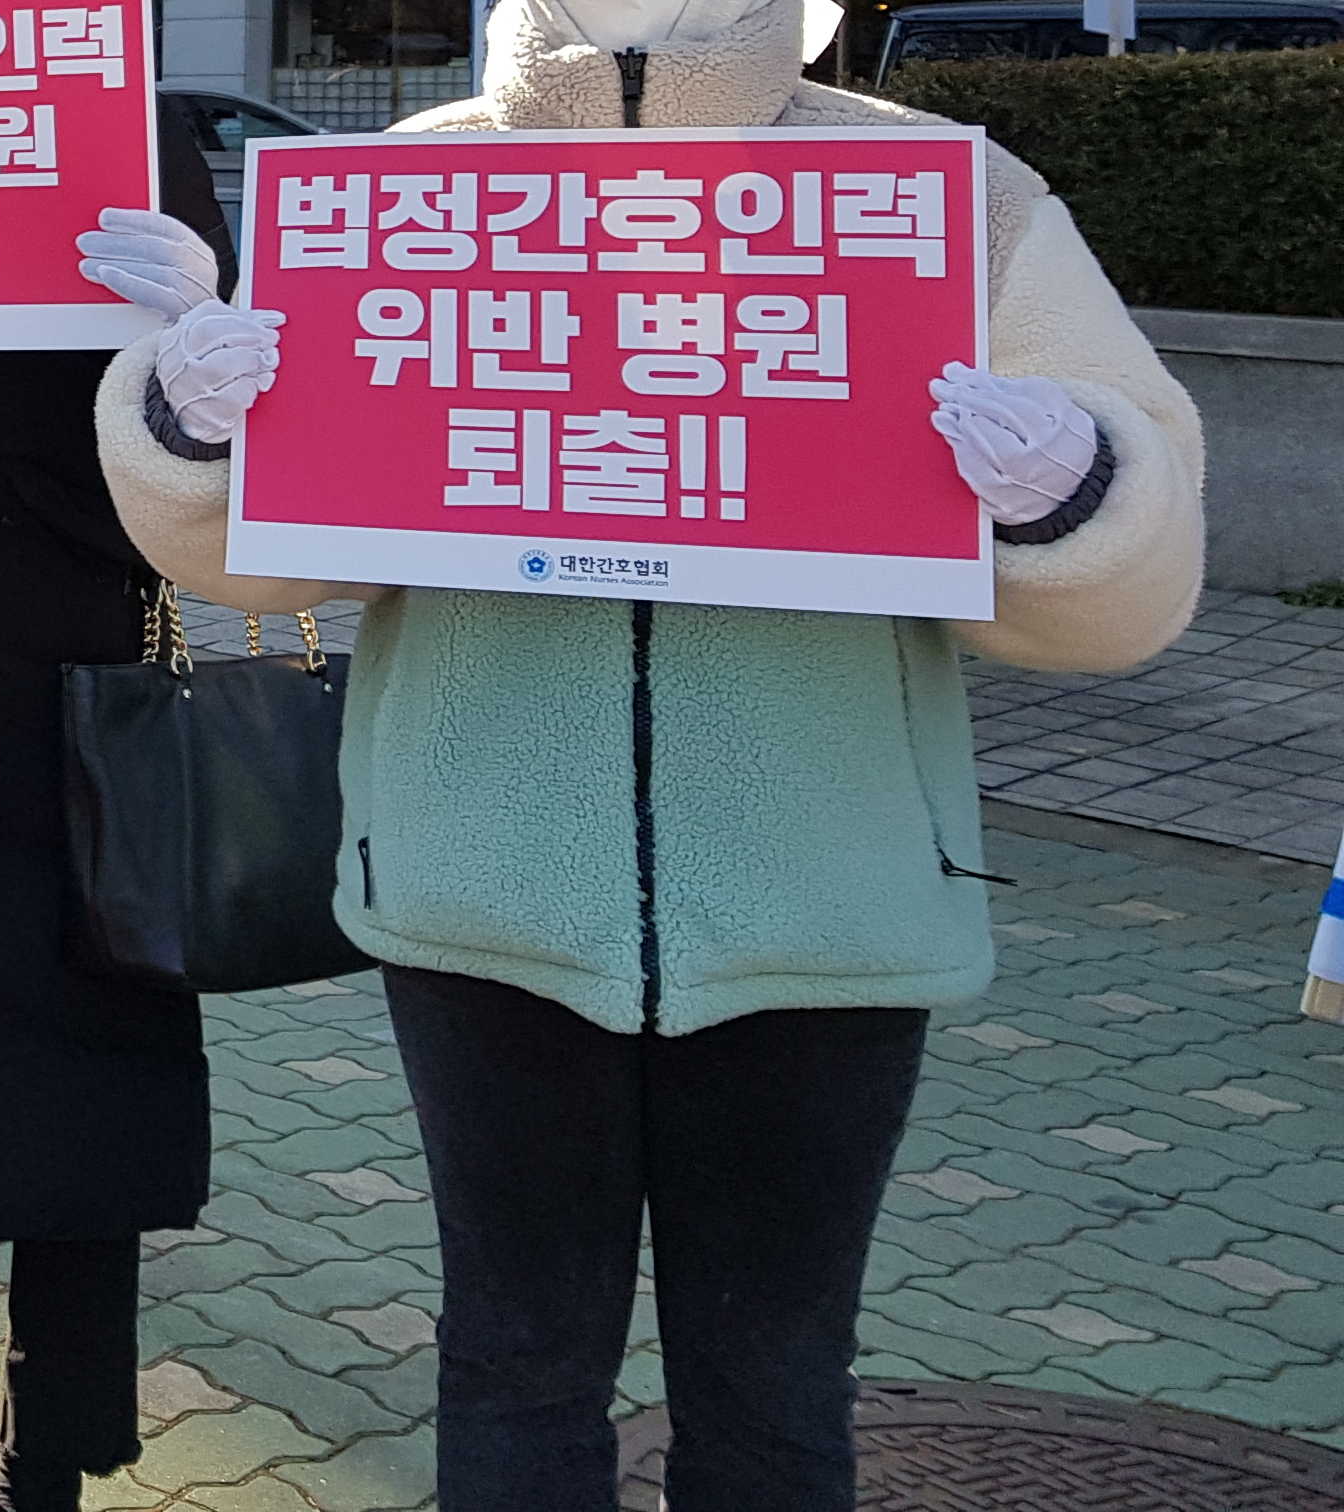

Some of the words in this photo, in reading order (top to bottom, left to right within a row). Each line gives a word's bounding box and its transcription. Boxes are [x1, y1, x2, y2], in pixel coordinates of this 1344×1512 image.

[276, 169, 947, 279] 법정간호인력
[354, 288, 583, 393] 위반
[617, 290, 851, 401] 병원
[443, 406, 747, 523] 퇴출!!
[560, 555, 670, 578] 대한간호협회
